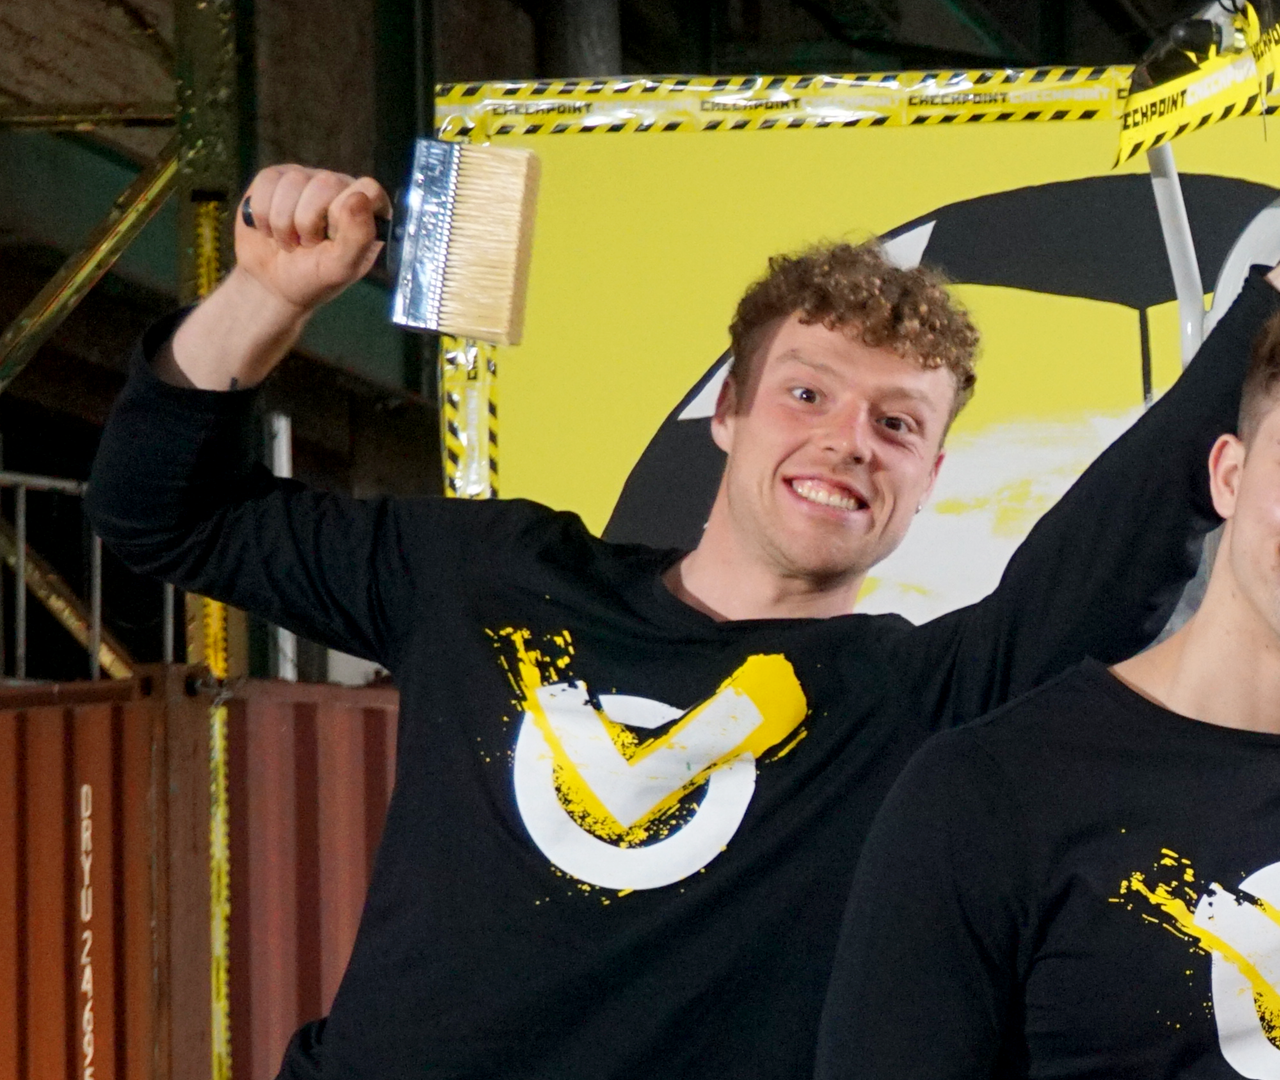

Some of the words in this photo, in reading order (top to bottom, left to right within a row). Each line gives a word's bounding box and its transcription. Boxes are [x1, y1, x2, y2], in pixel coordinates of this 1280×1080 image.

[909, 91, 1008, 106] CHECKPOINT
[1122, 89, 1187, 130] ECKPOINT
[80, 783, 93, 922] DRYU
